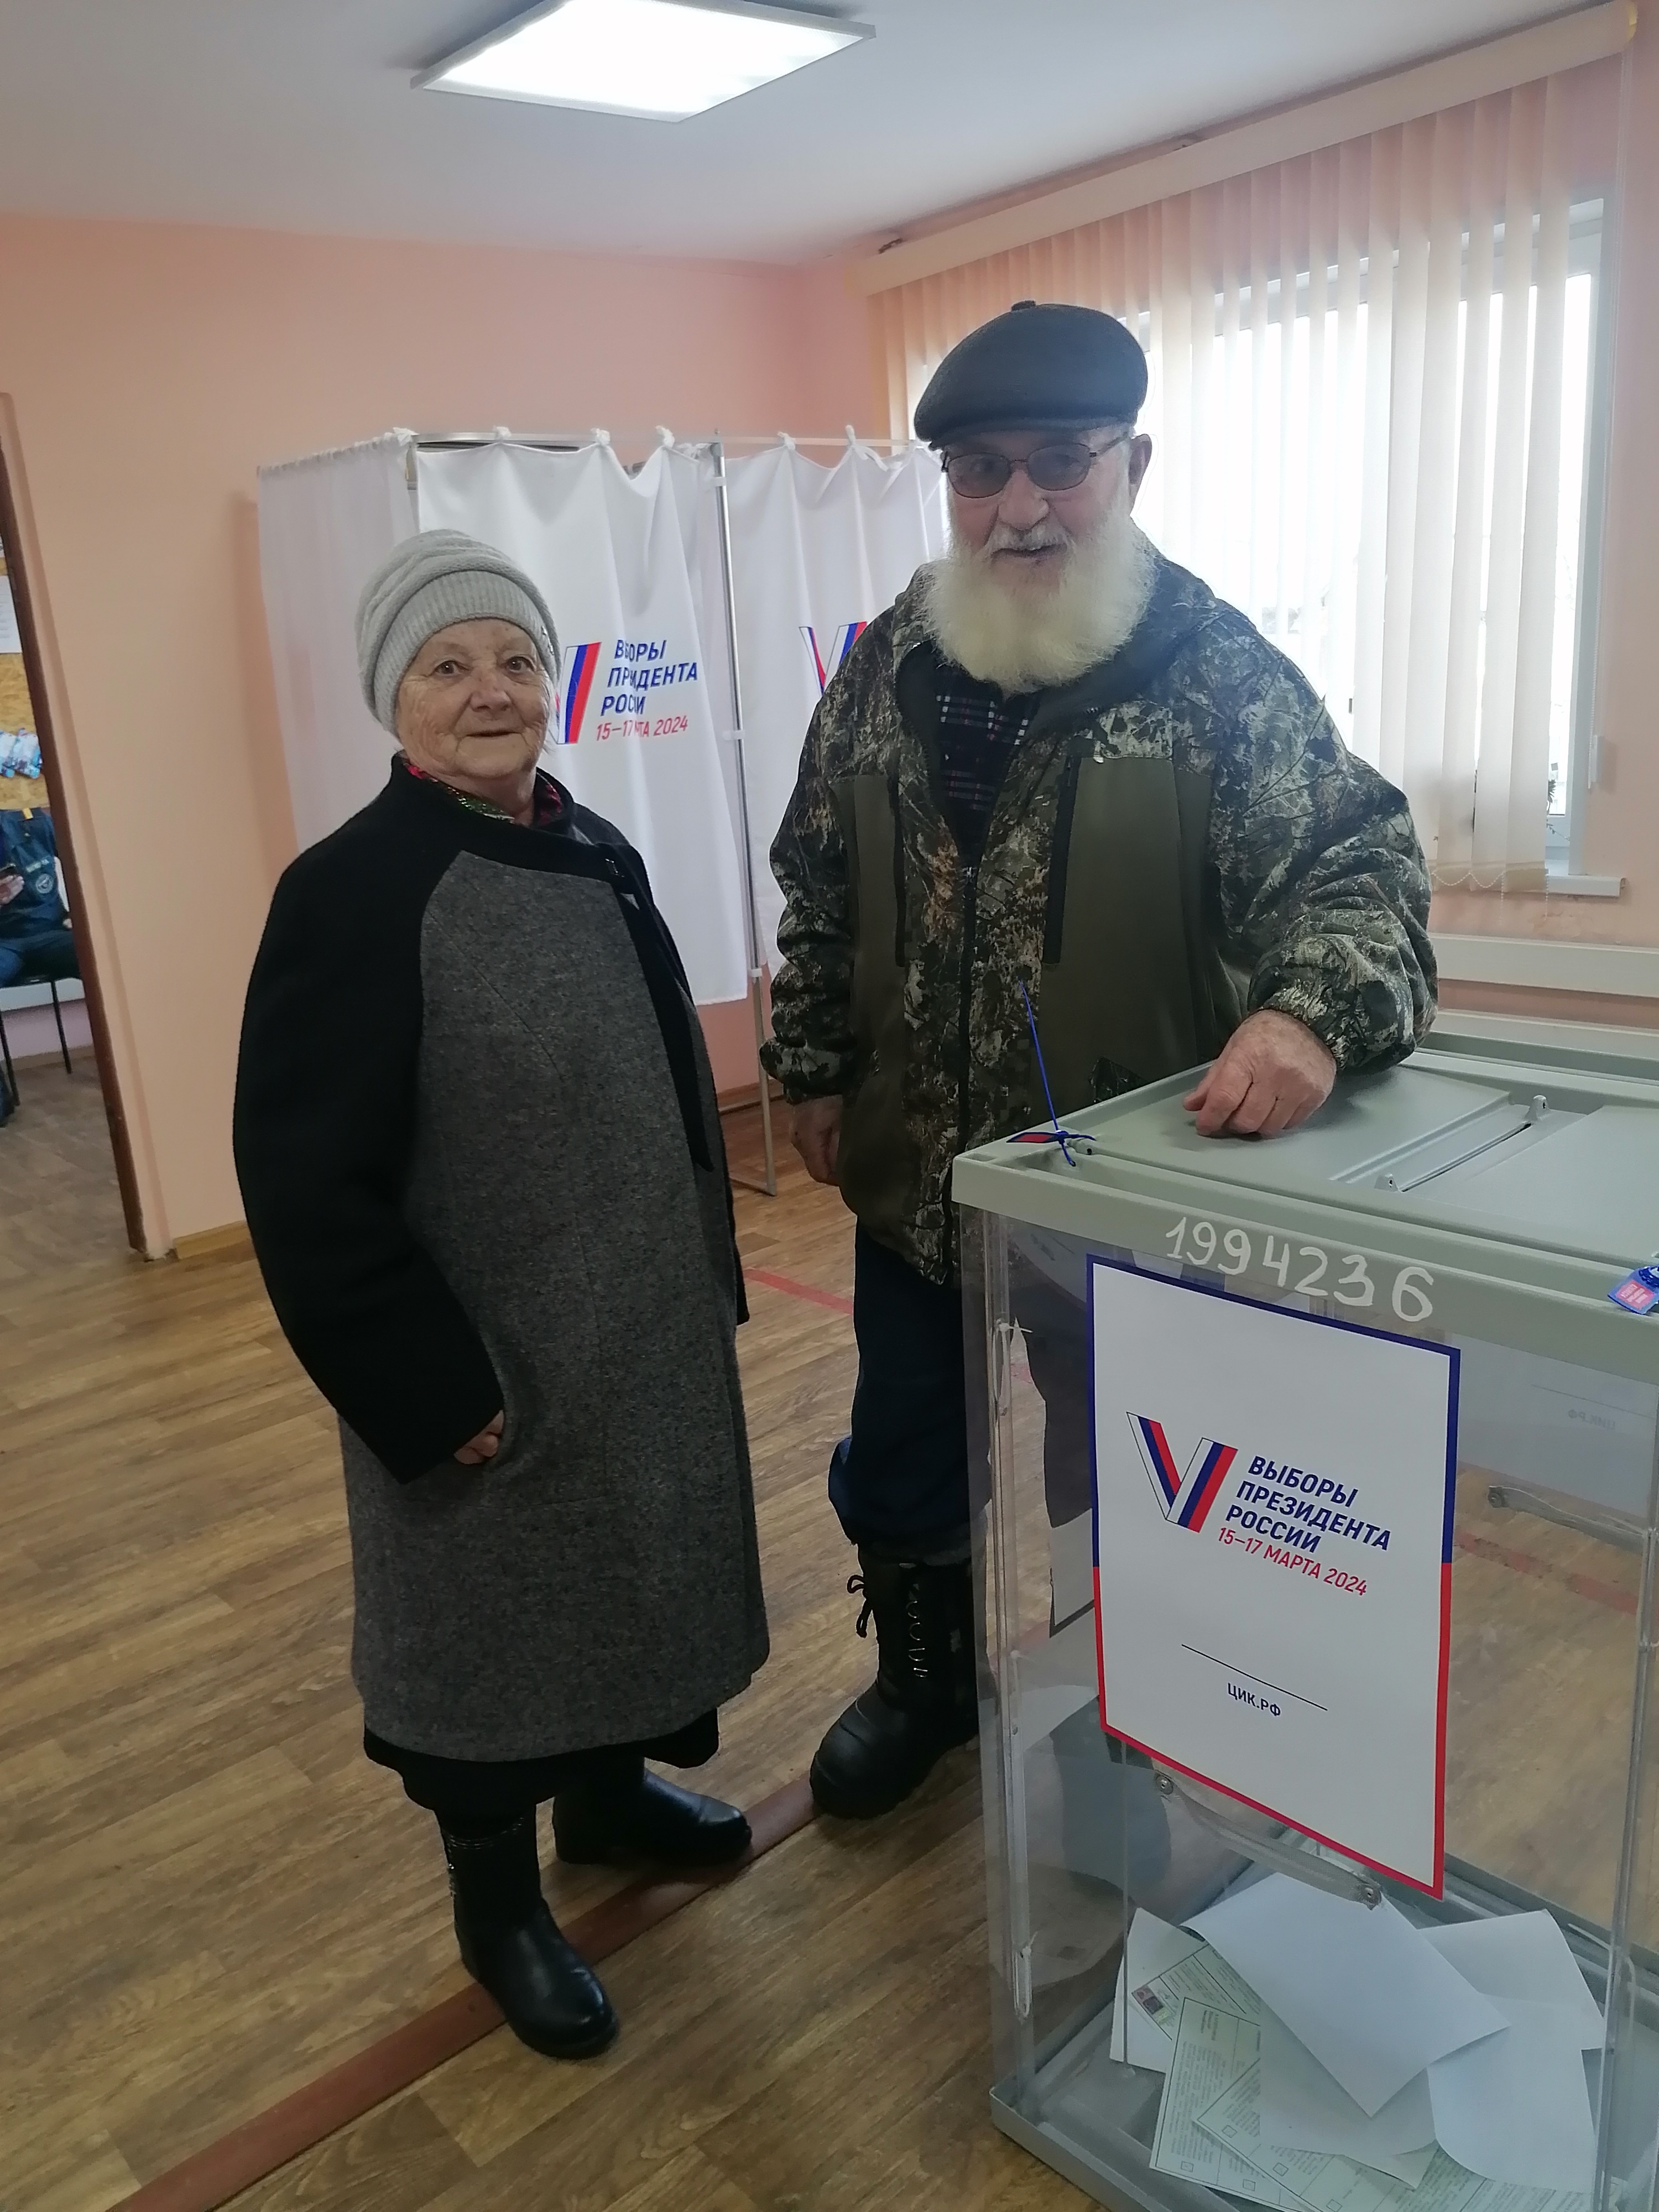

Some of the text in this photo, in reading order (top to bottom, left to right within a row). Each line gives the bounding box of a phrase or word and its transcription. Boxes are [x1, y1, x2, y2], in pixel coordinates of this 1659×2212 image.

[614, 639, 667, 662] ВБОРЫ
[653, 715, 688, 737] 2024
[1166, 1217, 1434, 1322] 1994236
[1248, 1455, 1359, 1508] ВЫБОРЫ
[1225, 1504, 1322, 1553] РОССИИ
[1235, 1480, 1392, 1551] ПРЕЗИДЕНТА
[1264, 1545, 1322, 1579] МАРТА
[1323, 1568, 1367, 1597] 2024
[1227, 1682, 1281, 1717] ЦИК.РФ
